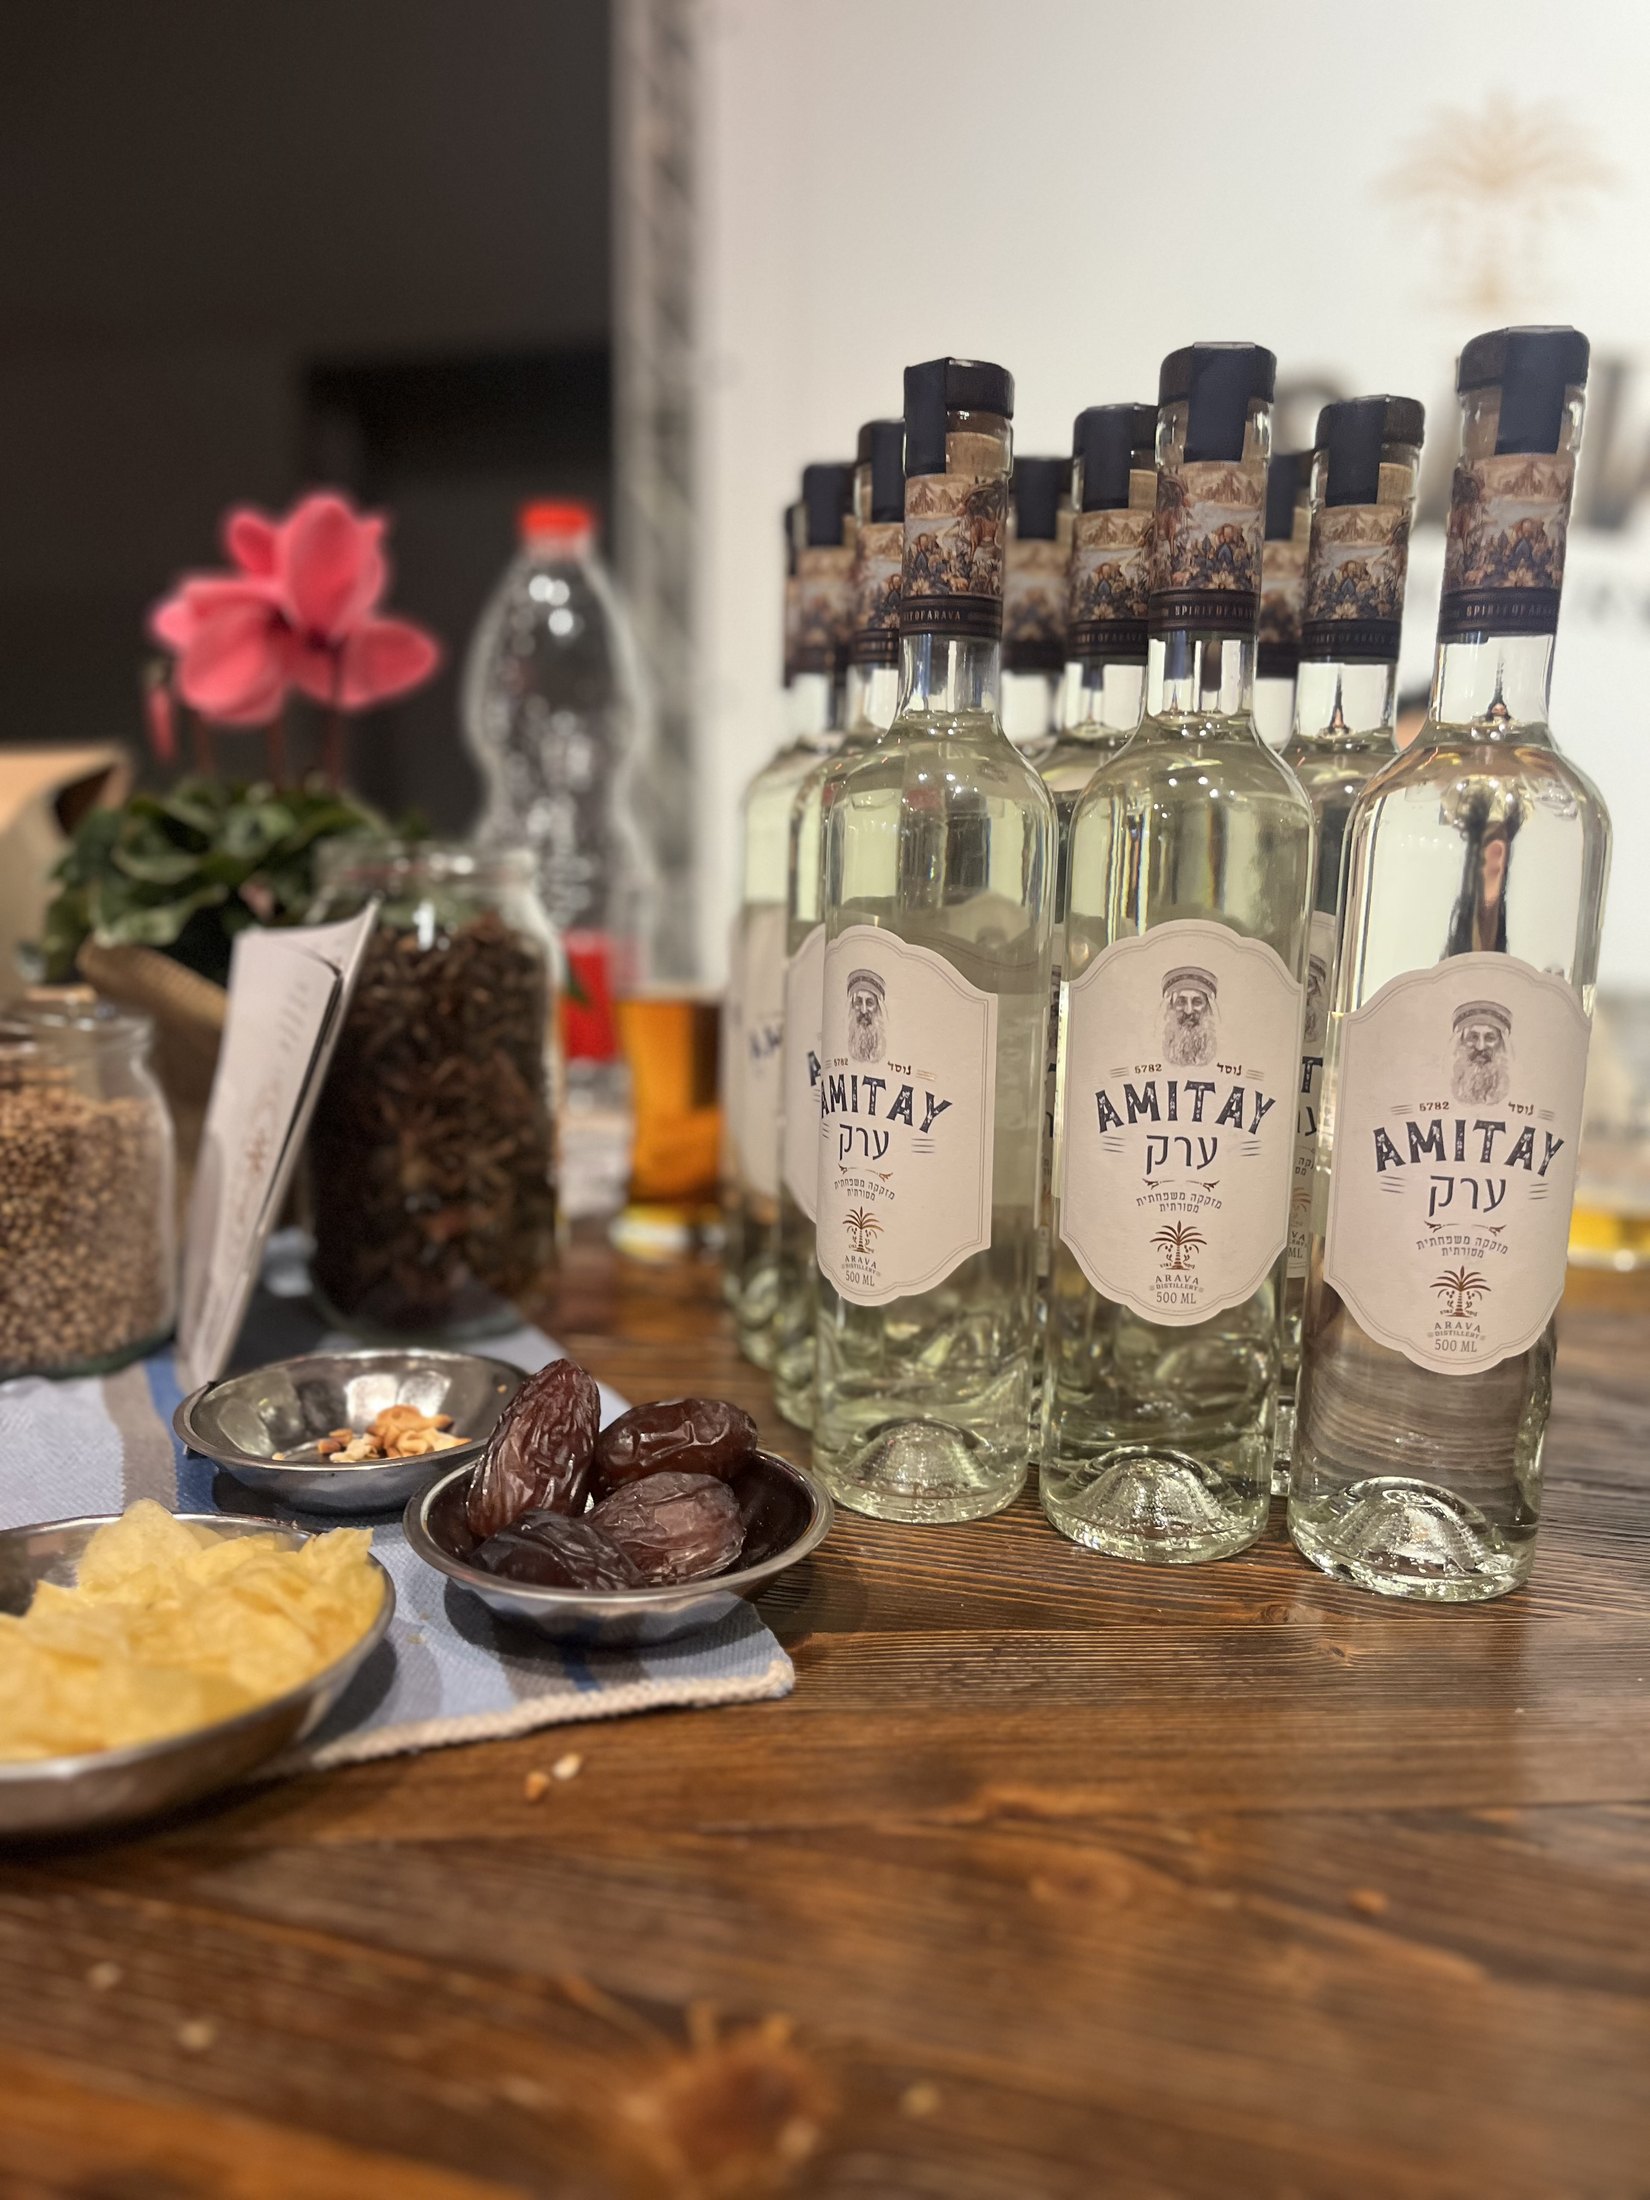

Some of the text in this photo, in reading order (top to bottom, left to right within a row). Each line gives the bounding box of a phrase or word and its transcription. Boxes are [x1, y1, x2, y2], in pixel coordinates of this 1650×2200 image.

[927, 610, 961, 621] ARAVA
[833, 1058, 849, 1067] 5782
[1134, 1063, 1163, 1074] 5782
[821, 1074, 953, 1134] AMITAY
[1095, 1080, 1276, 1135] AMITAY
[1419, 1101, 1450, 1111] 5782
[839, 1123, 889, 1161] ערק
[1373, 1119, 1565, 1177] AMITAY
[1146, 1135, 1218, 1175] ערק
[1136, 1191, 1223, 1210] מזקקה משפחתית
[1428, 1175, 1506, 1218] ערק
[1159, 1203, 1200, 1213] מסורתית
[1416, 1235, 1509, 1255] מזקקה משפחתית
[1441, 1246, 1484, 1258] מסורתית
[845, 1255, 877, 1269] ARAVA
[845, 1270, 875, 1287] 500 ML
[1155, 1274, 1199, 1285] ARAVA
[1156, 1291, 1197, 1305] 500 ML
[1434, 1321, 1480, 1333] ARAVA
[1434, 1339, 1478, 1353] 500 ML
